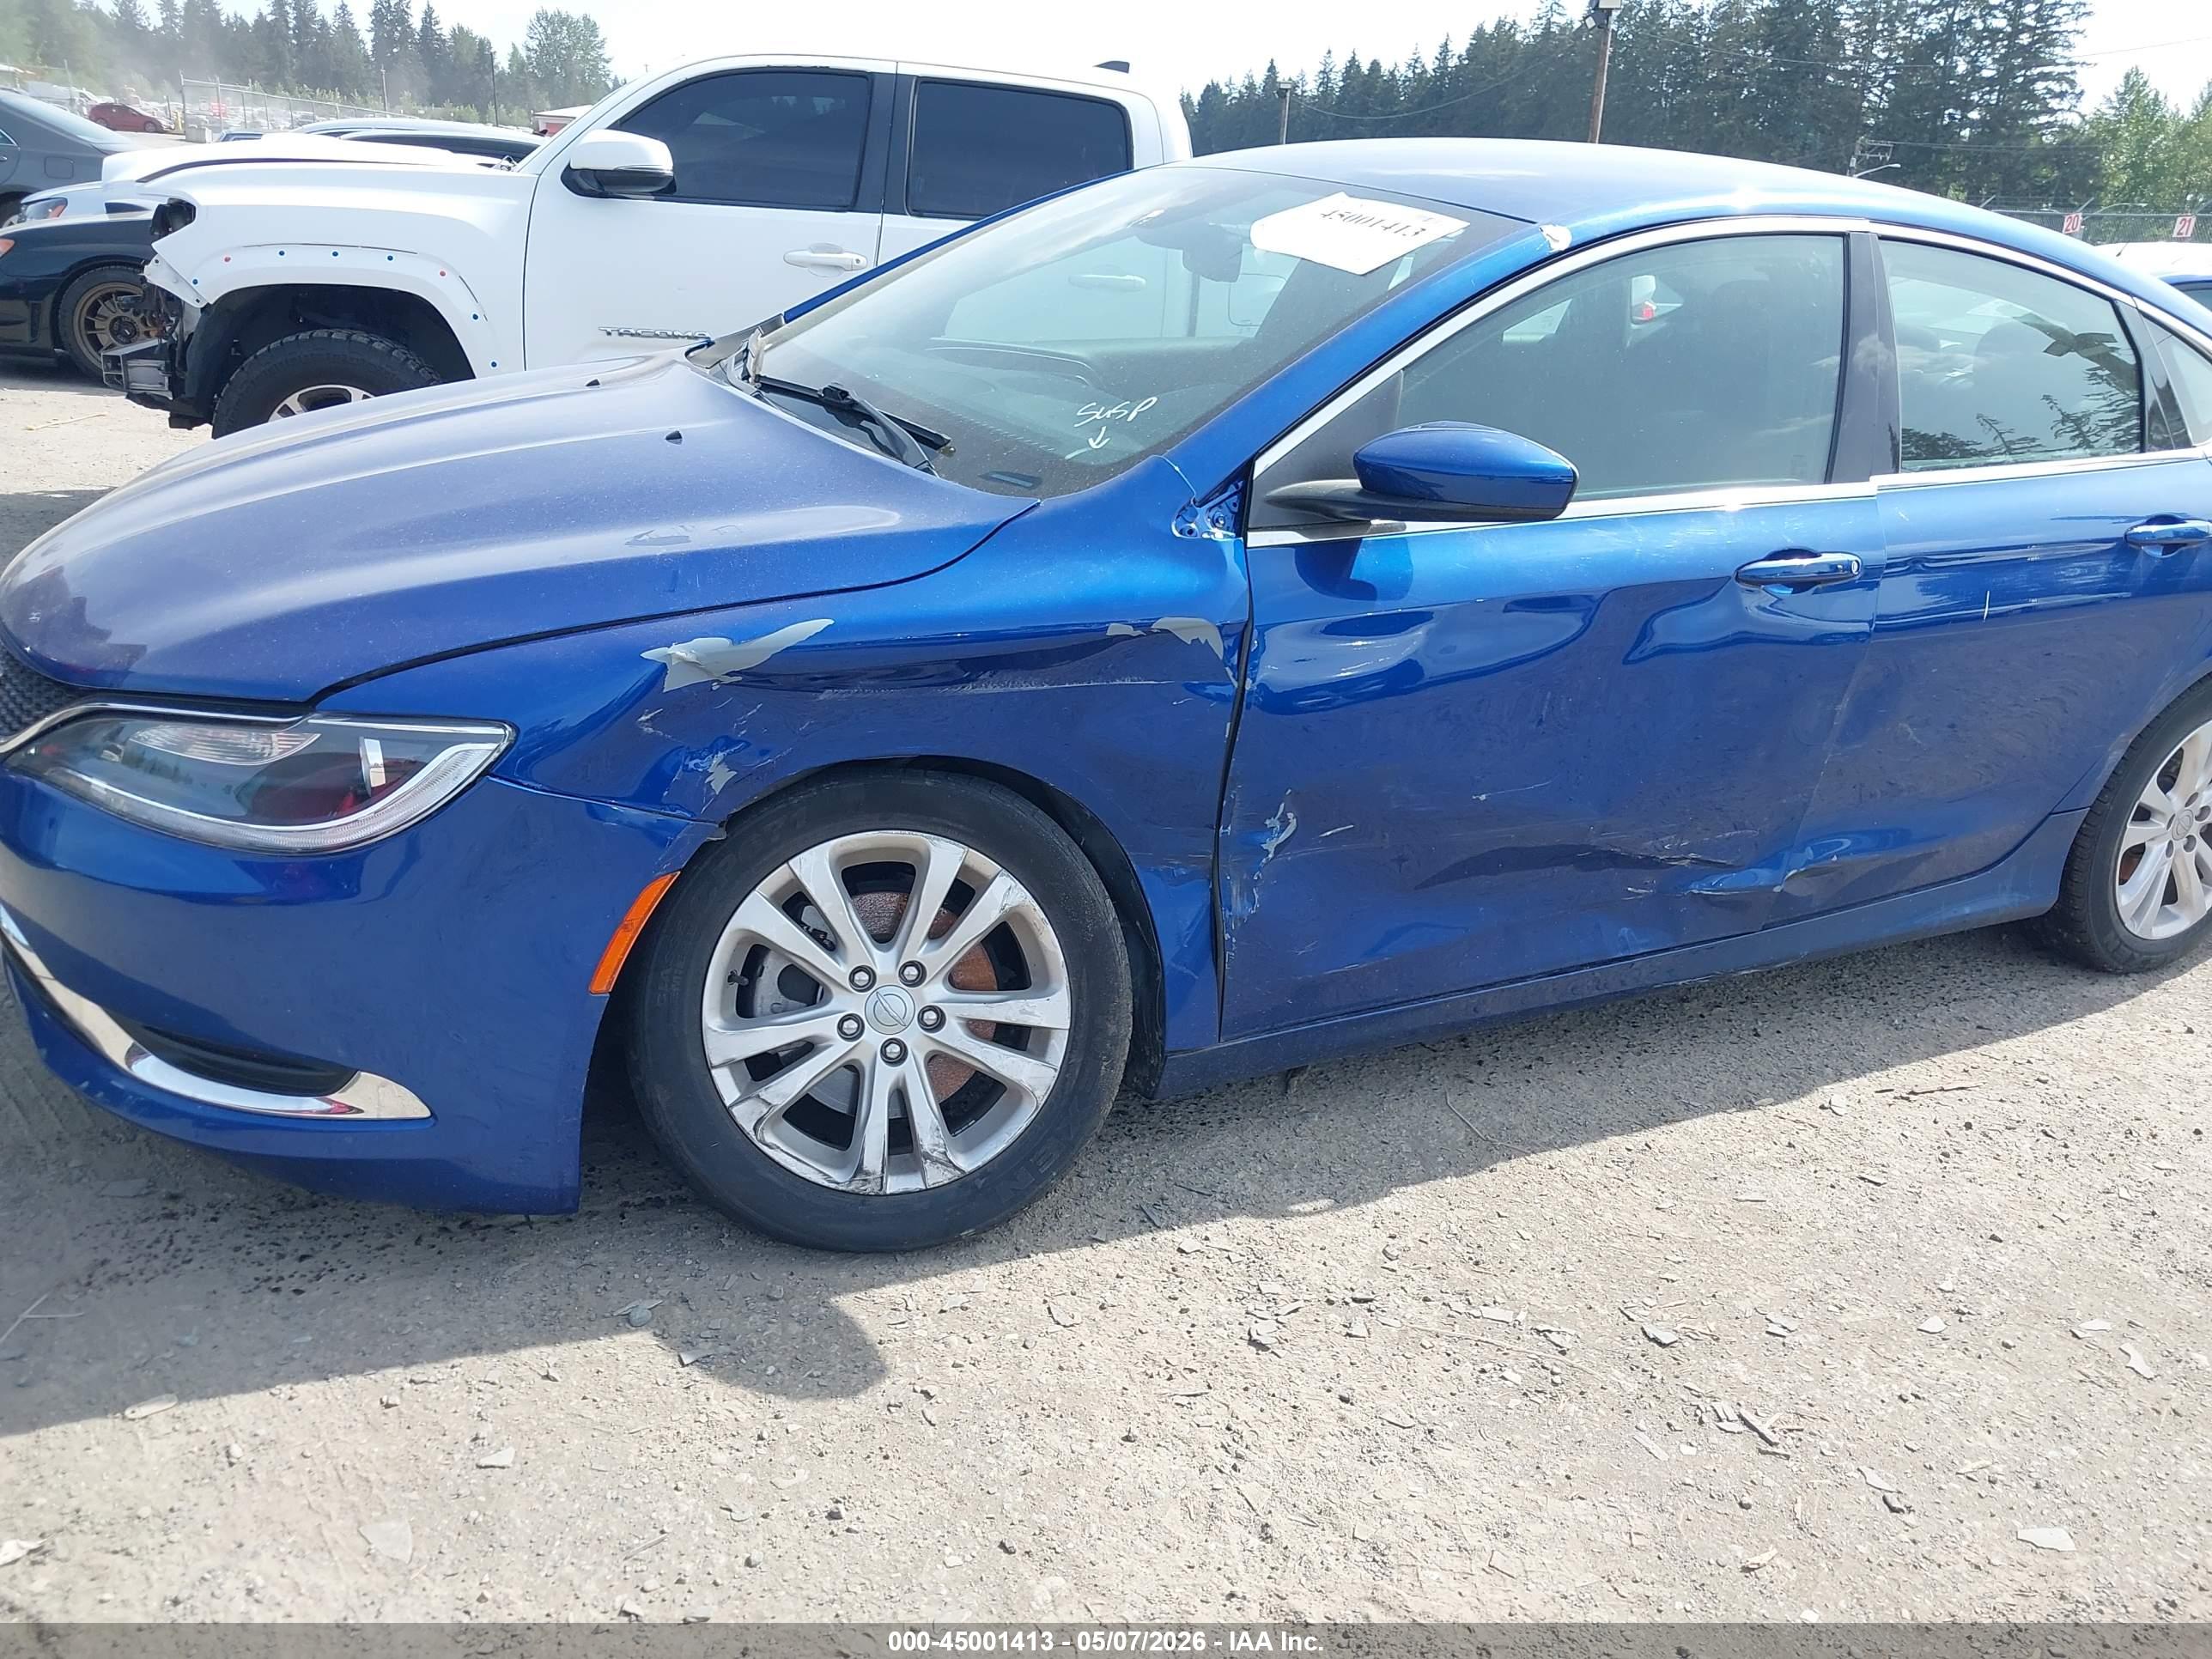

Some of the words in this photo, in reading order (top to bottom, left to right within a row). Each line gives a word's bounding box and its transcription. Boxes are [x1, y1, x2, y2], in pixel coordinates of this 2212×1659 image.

[2064, 215, 2079, 232] 20
[2177, 217, 2191, 236] 21
[599, 326, 710, 340] TACOMA
